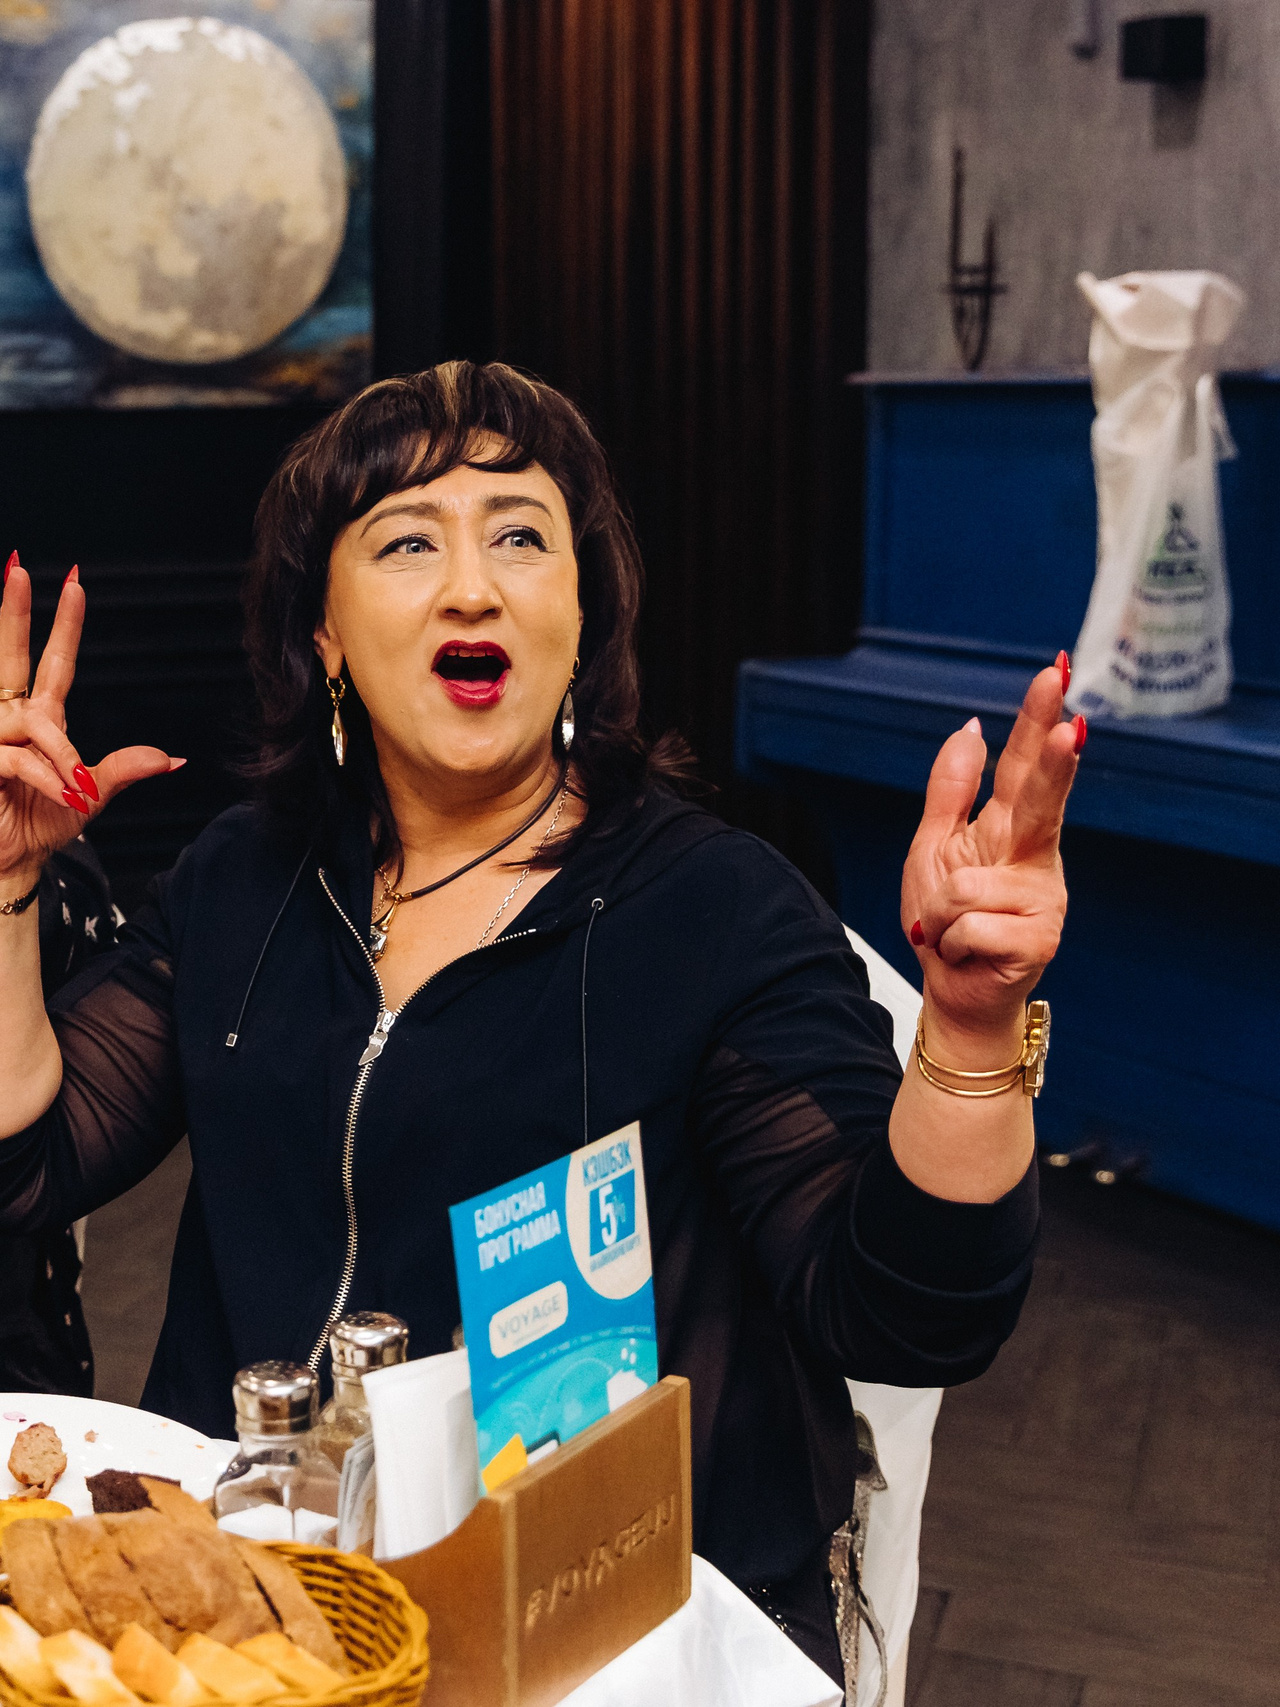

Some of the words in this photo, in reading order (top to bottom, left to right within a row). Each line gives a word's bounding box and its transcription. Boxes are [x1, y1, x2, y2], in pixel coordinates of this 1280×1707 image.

[582, 1138, 632, 1187] КЭШБЭК
[474, 1181, 546, 1239] БОНУСНАЯ
[478, 1209, 561, 1271] ПРОГРАММА
[497, 1293, 560, 1339] VOYAGE
